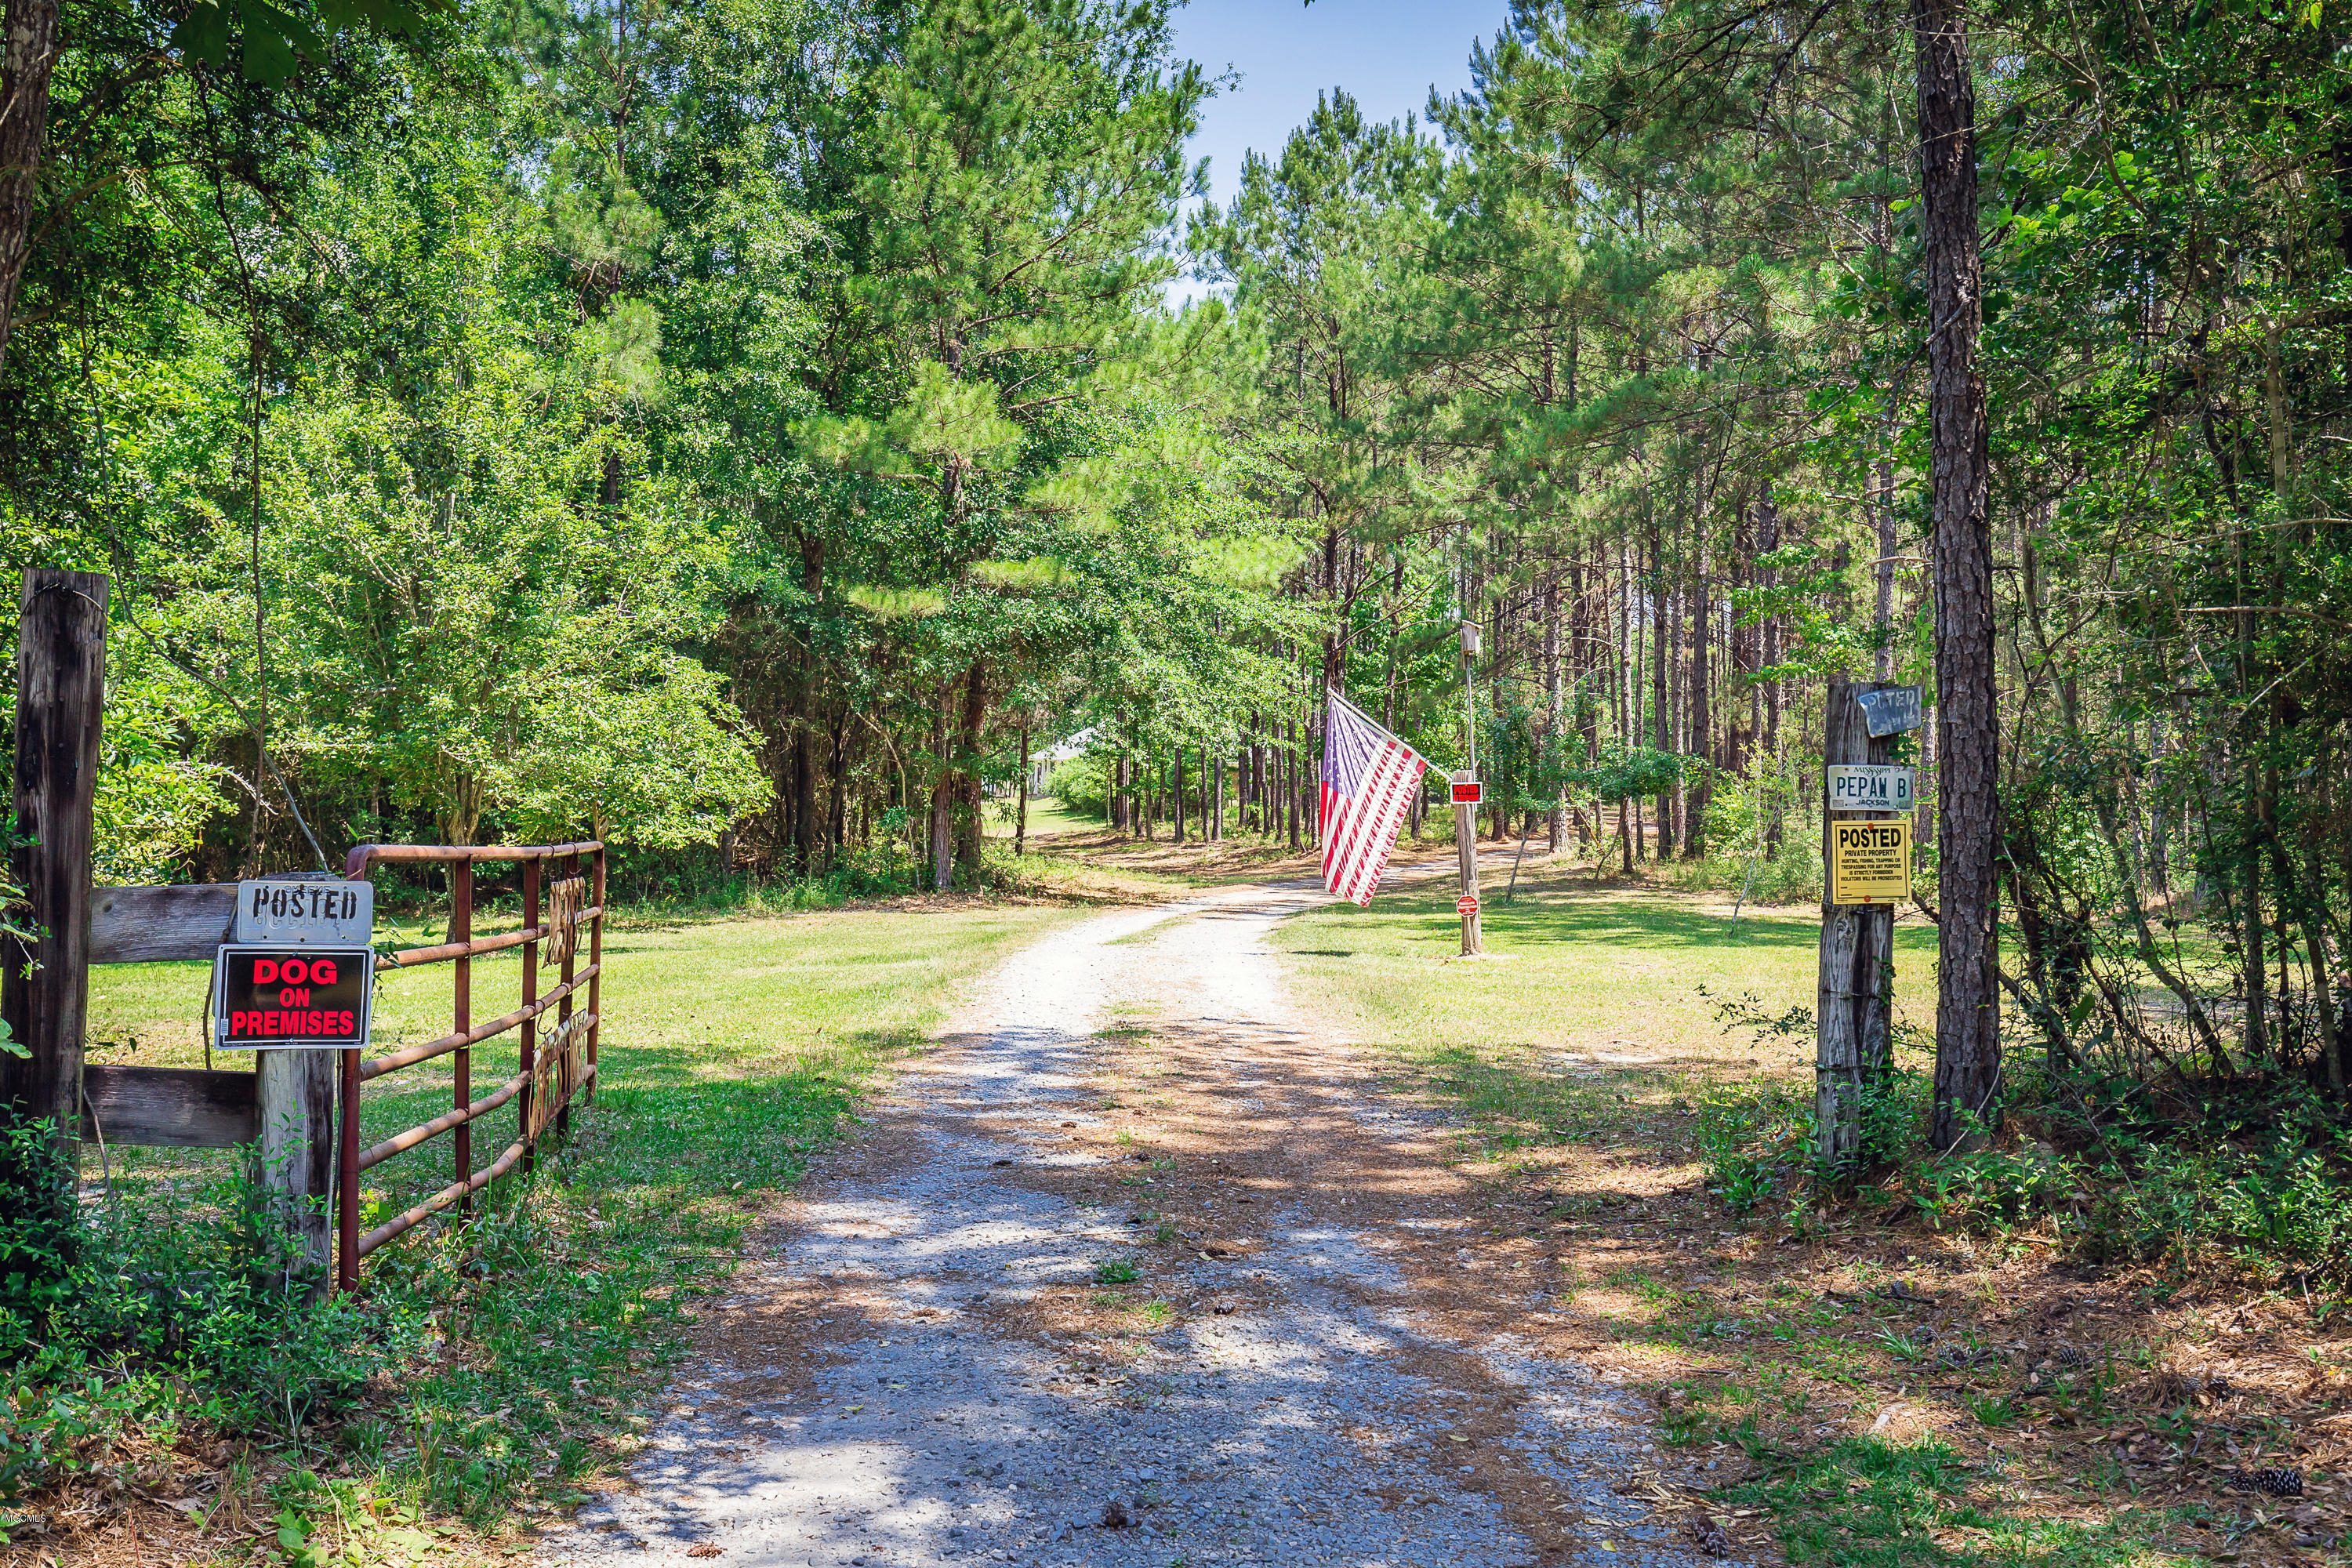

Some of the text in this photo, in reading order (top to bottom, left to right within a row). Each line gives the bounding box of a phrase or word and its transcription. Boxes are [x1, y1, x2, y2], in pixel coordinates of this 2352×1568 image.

[1454, 785, 1479, 794] POSTED
[1897, 778, 1907, 798] B
[1839, 828, 1901, 848] POSTED
[253, 887, 358, 920] POSTED
[252, 959, 338, 985] DOG
[279, 988, 310, 1007] ON
[231, 1010, 354, 1036] PREMISES
